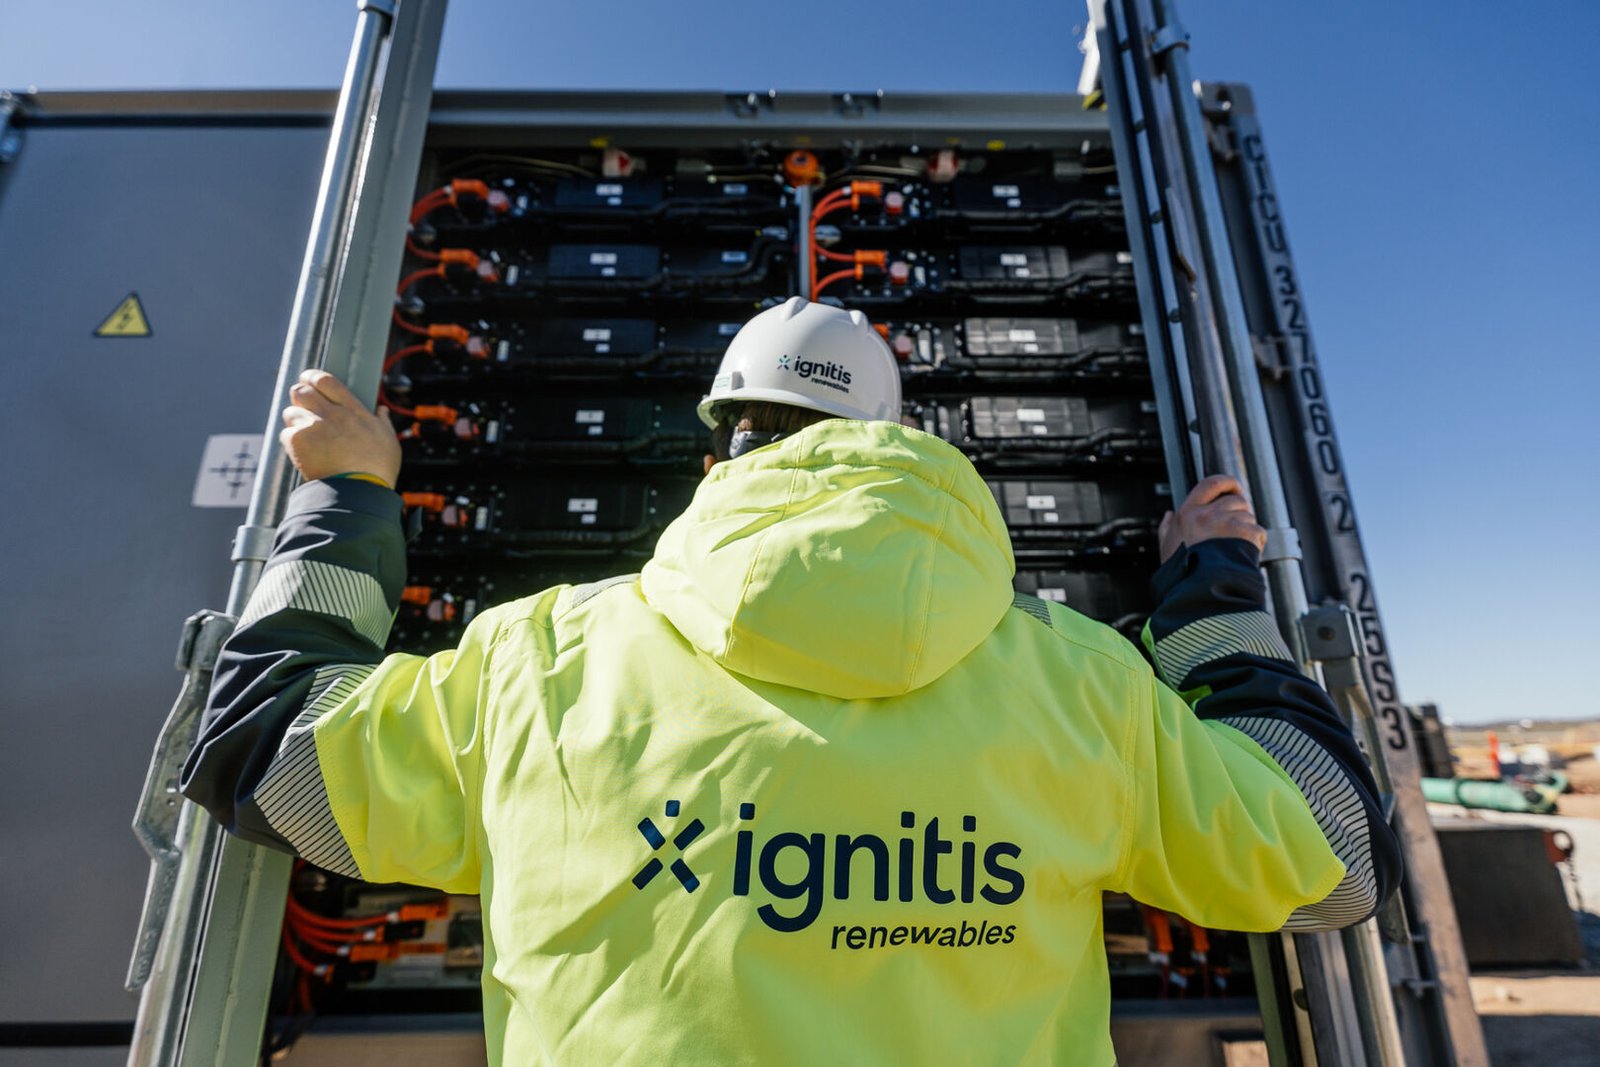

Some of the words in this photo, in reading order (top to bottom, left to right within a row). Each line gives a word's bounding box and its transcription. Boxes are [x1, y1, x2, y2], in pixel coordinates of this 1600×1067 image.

[1243, 135, 1287, 252] CICU
[1275, 266, 1339, 475] 327060
[1331, 496, 1354, 533] 2
[795, 355, 852, 384] ignitis
[811, 377, 849, 393] renewables
[733, 803, 1025, 933] ignitis
[831, 920, 1017, 949] renewables
